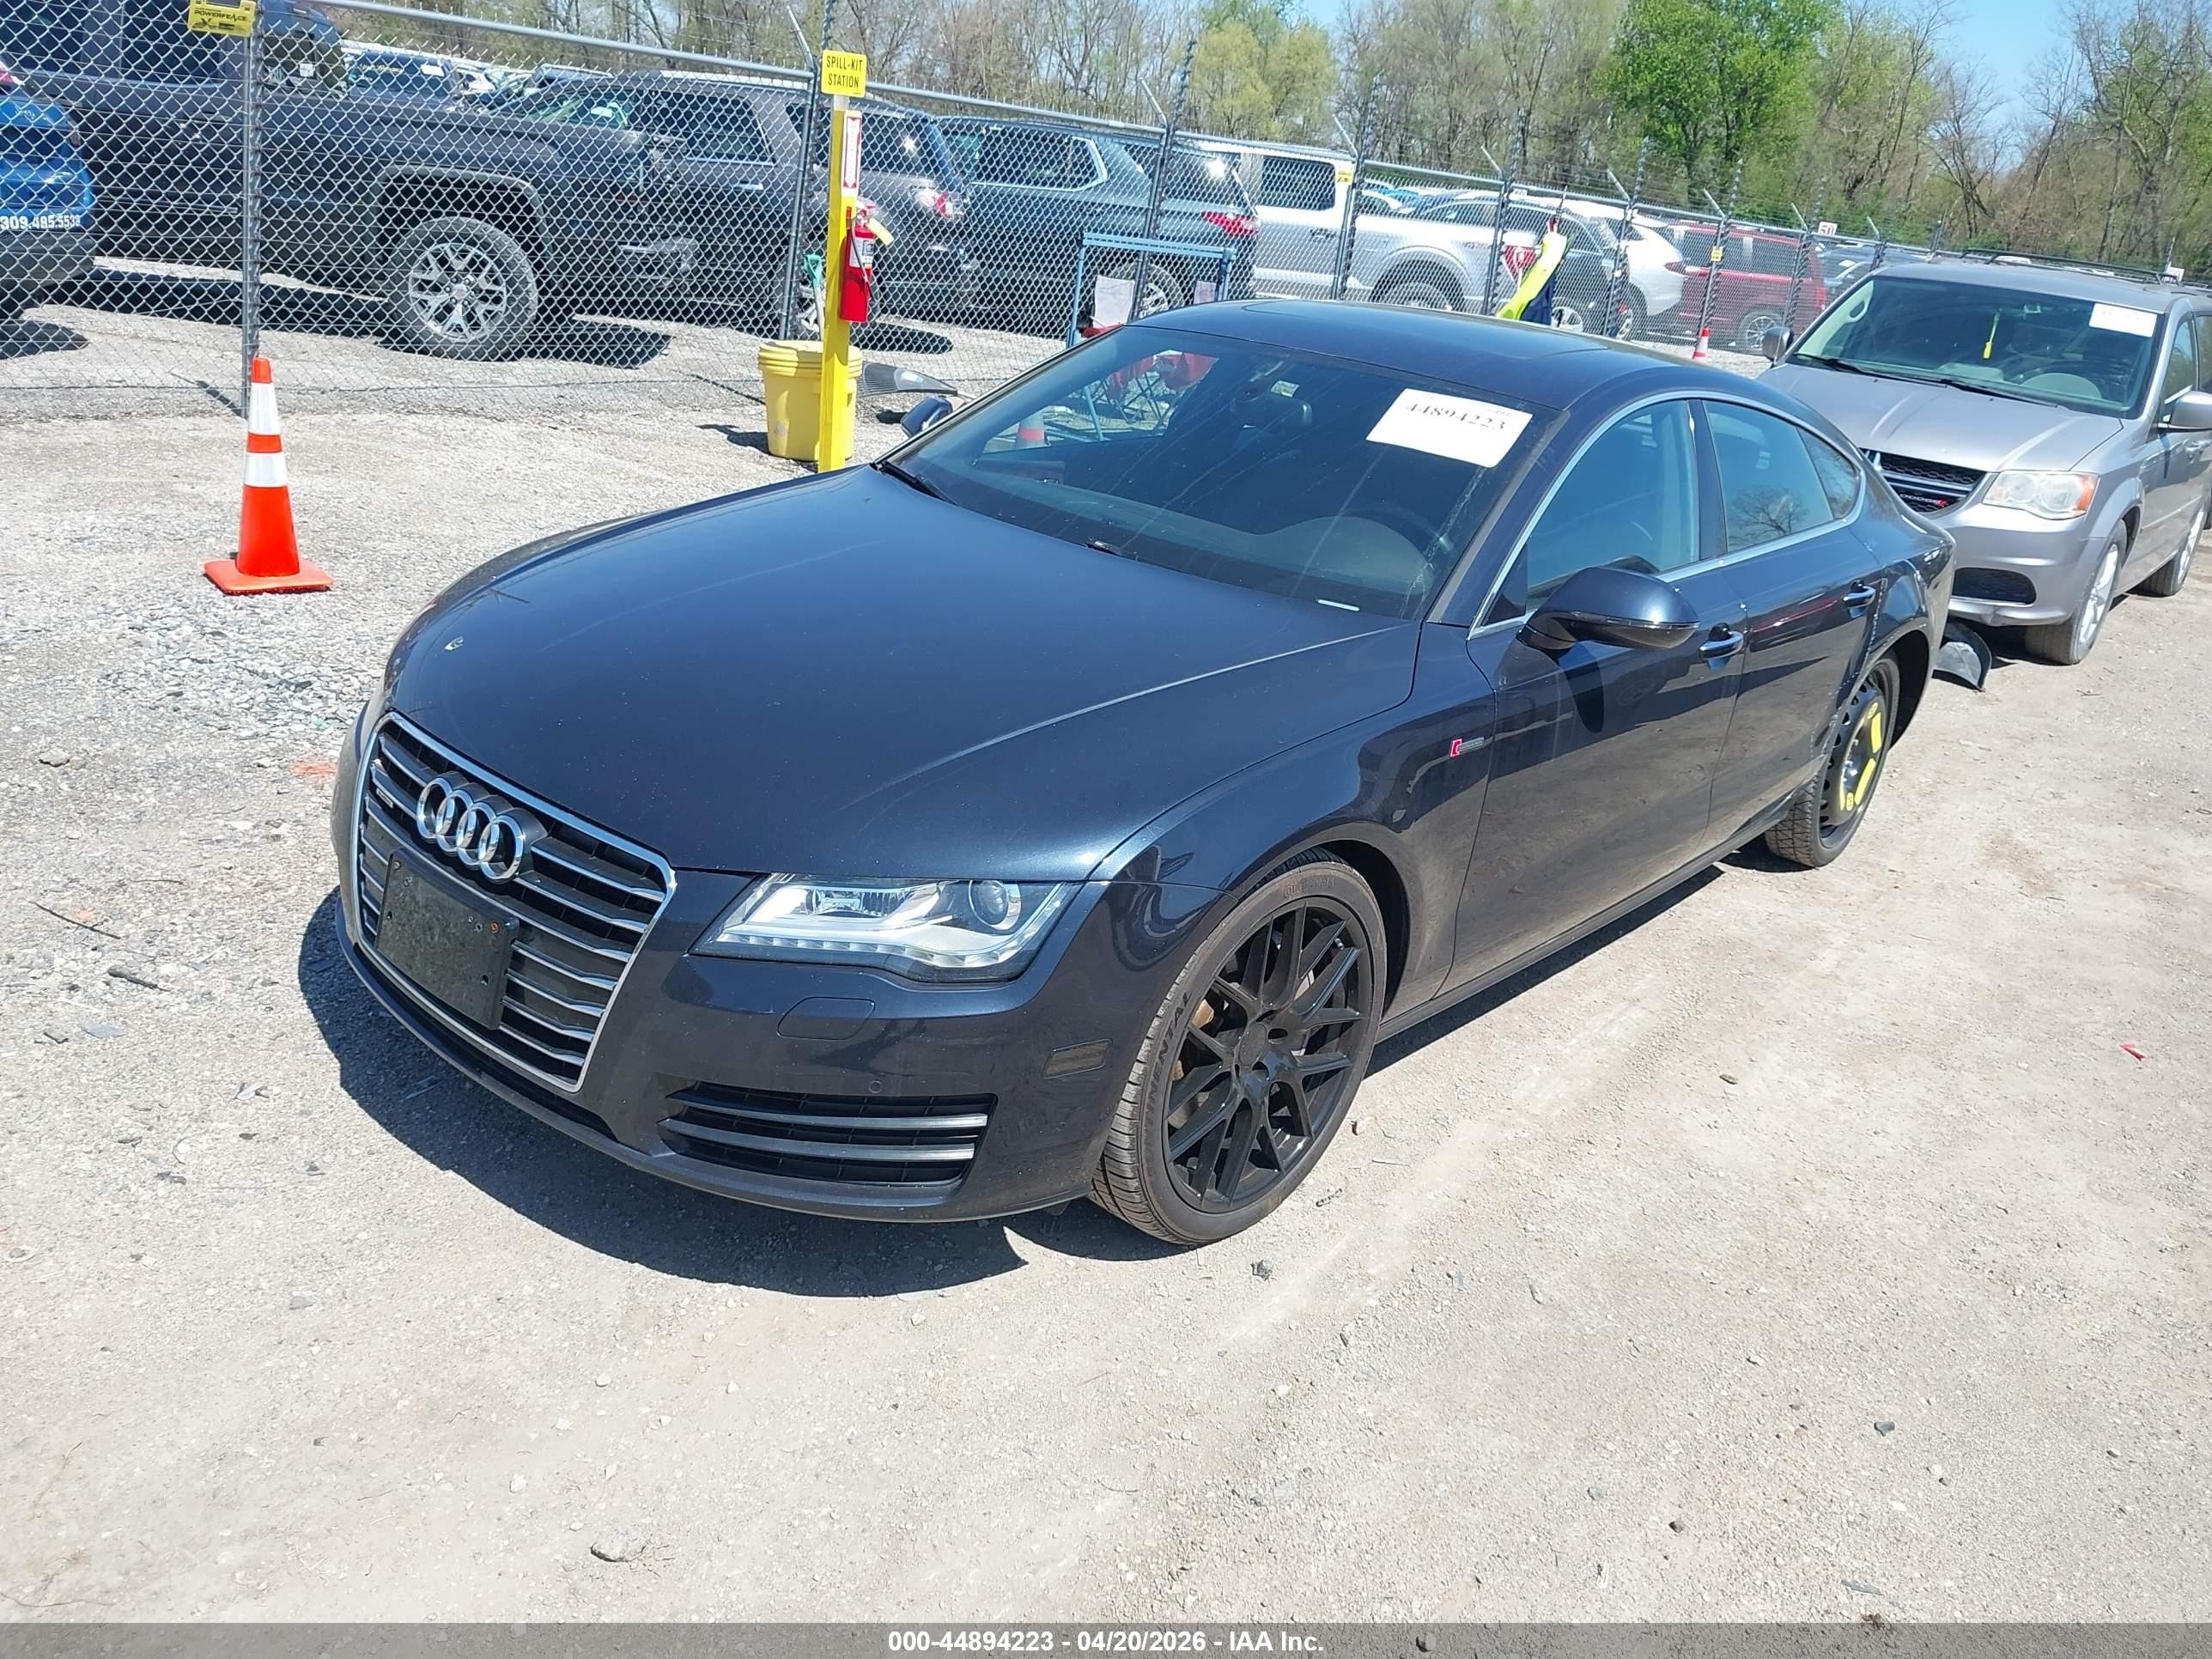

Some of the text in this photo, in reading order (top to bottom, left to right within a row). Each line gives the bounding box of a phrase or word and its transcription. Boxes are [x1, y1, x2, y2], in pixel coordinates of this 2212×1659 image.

[826, 55, 863, 72] SPILL-KIT
[828, 73, 860, 88] STATION
[1406, 404, 1505, 429] 44894223
